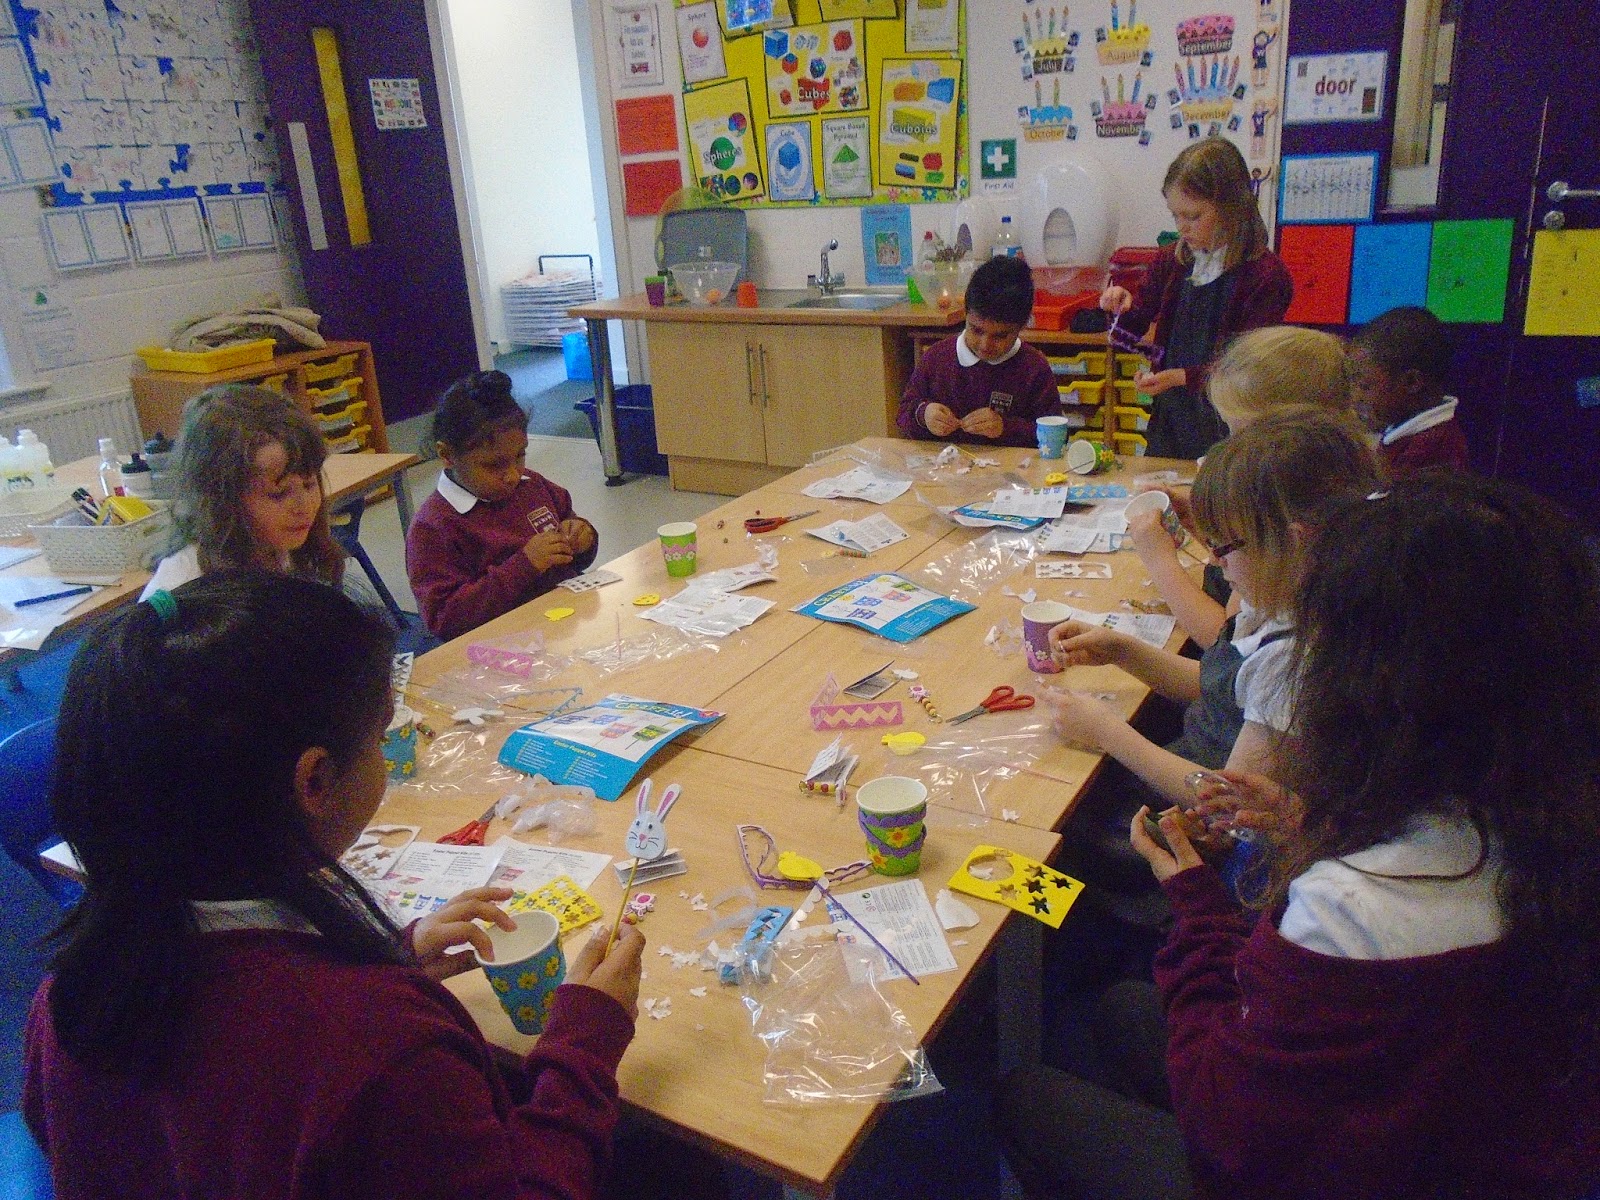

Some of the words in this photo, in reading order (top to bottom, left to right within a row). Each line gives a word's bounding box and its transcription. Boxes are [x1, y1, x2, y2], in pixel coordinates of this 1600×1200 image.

[1179, 40, 1233, 53] September
[1106, 49, 1139, 60] August
[798, 86, 830, 99] Cubes
[1315, 76, 1357, 96] door
[890, 123, 938, 135] Cuboids
[1029, 128, 1064, 139] October
[703, 146, 742, 166] Spheres
